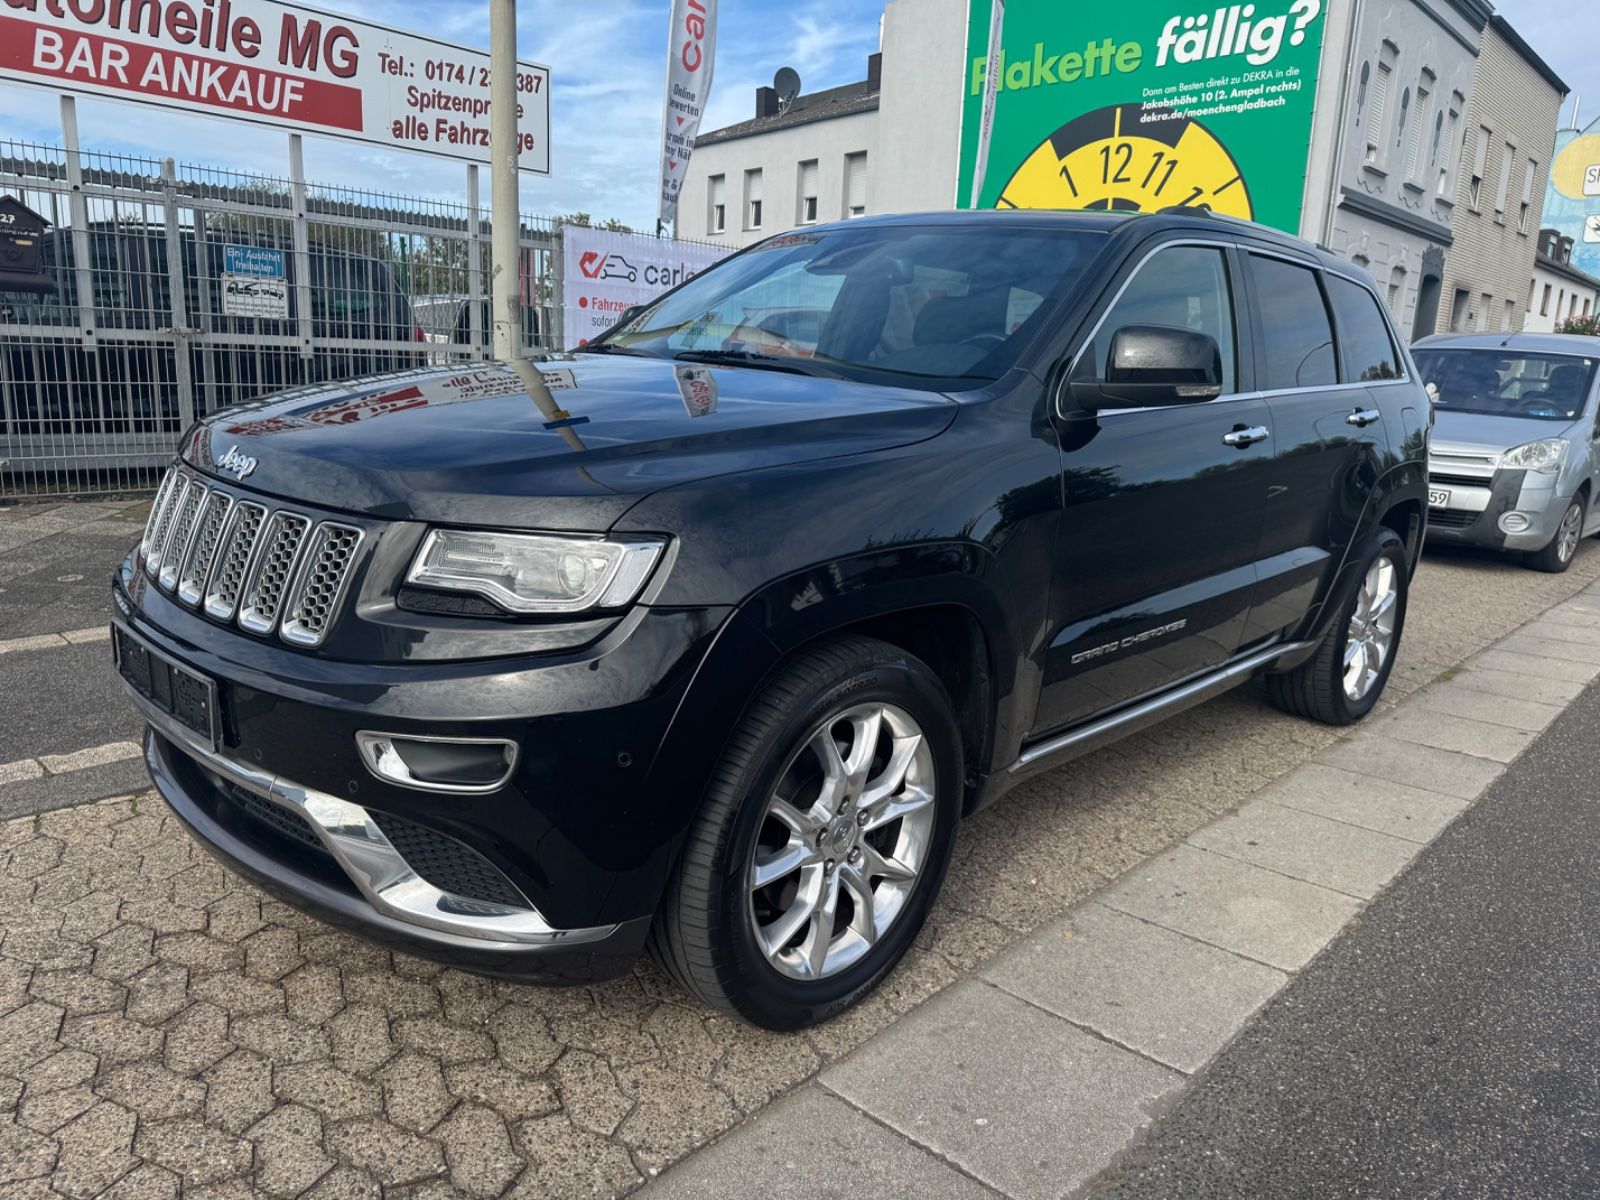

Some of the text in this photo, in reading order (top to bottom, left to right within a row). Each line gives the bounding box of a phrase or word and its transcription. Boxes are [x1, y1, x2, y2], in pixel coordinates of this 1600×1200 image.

[278, 13, 360, 78] MG
[970, 38, 1143, 95] Plakette
[1155, 0, 1321, 66] fällig?
[33, 28, 305, 113] BAR ANKAUF
[377, 52, 414, 78] Tel.:
[425, 59, 465, 84] 0174
[468, 66, 476, 85] /
[1142, 65, 1300, 97] Dann am Besten direkt zu DEKRA in die
[673, 83, 696, 102] Online
[1141, 78, 1302, 111] Jakobshöhe 10 (2. Ampel rechts)
[1140, 96, 1286, 123] dekra.de/moenchengladbach
[391, 115, 429, 141] alle
[1100, 143, 1133, 184] 12
[1141, 151, 1178, 197] 11
[1059, 165, 1078, 198] 1
[235, 260, 273, 272] freihalten
[246, 250, 281, 262] Ausfahrt
[217, 445, 259, 480] Jeep
[1071, 641, 1119, 664] GRAND
